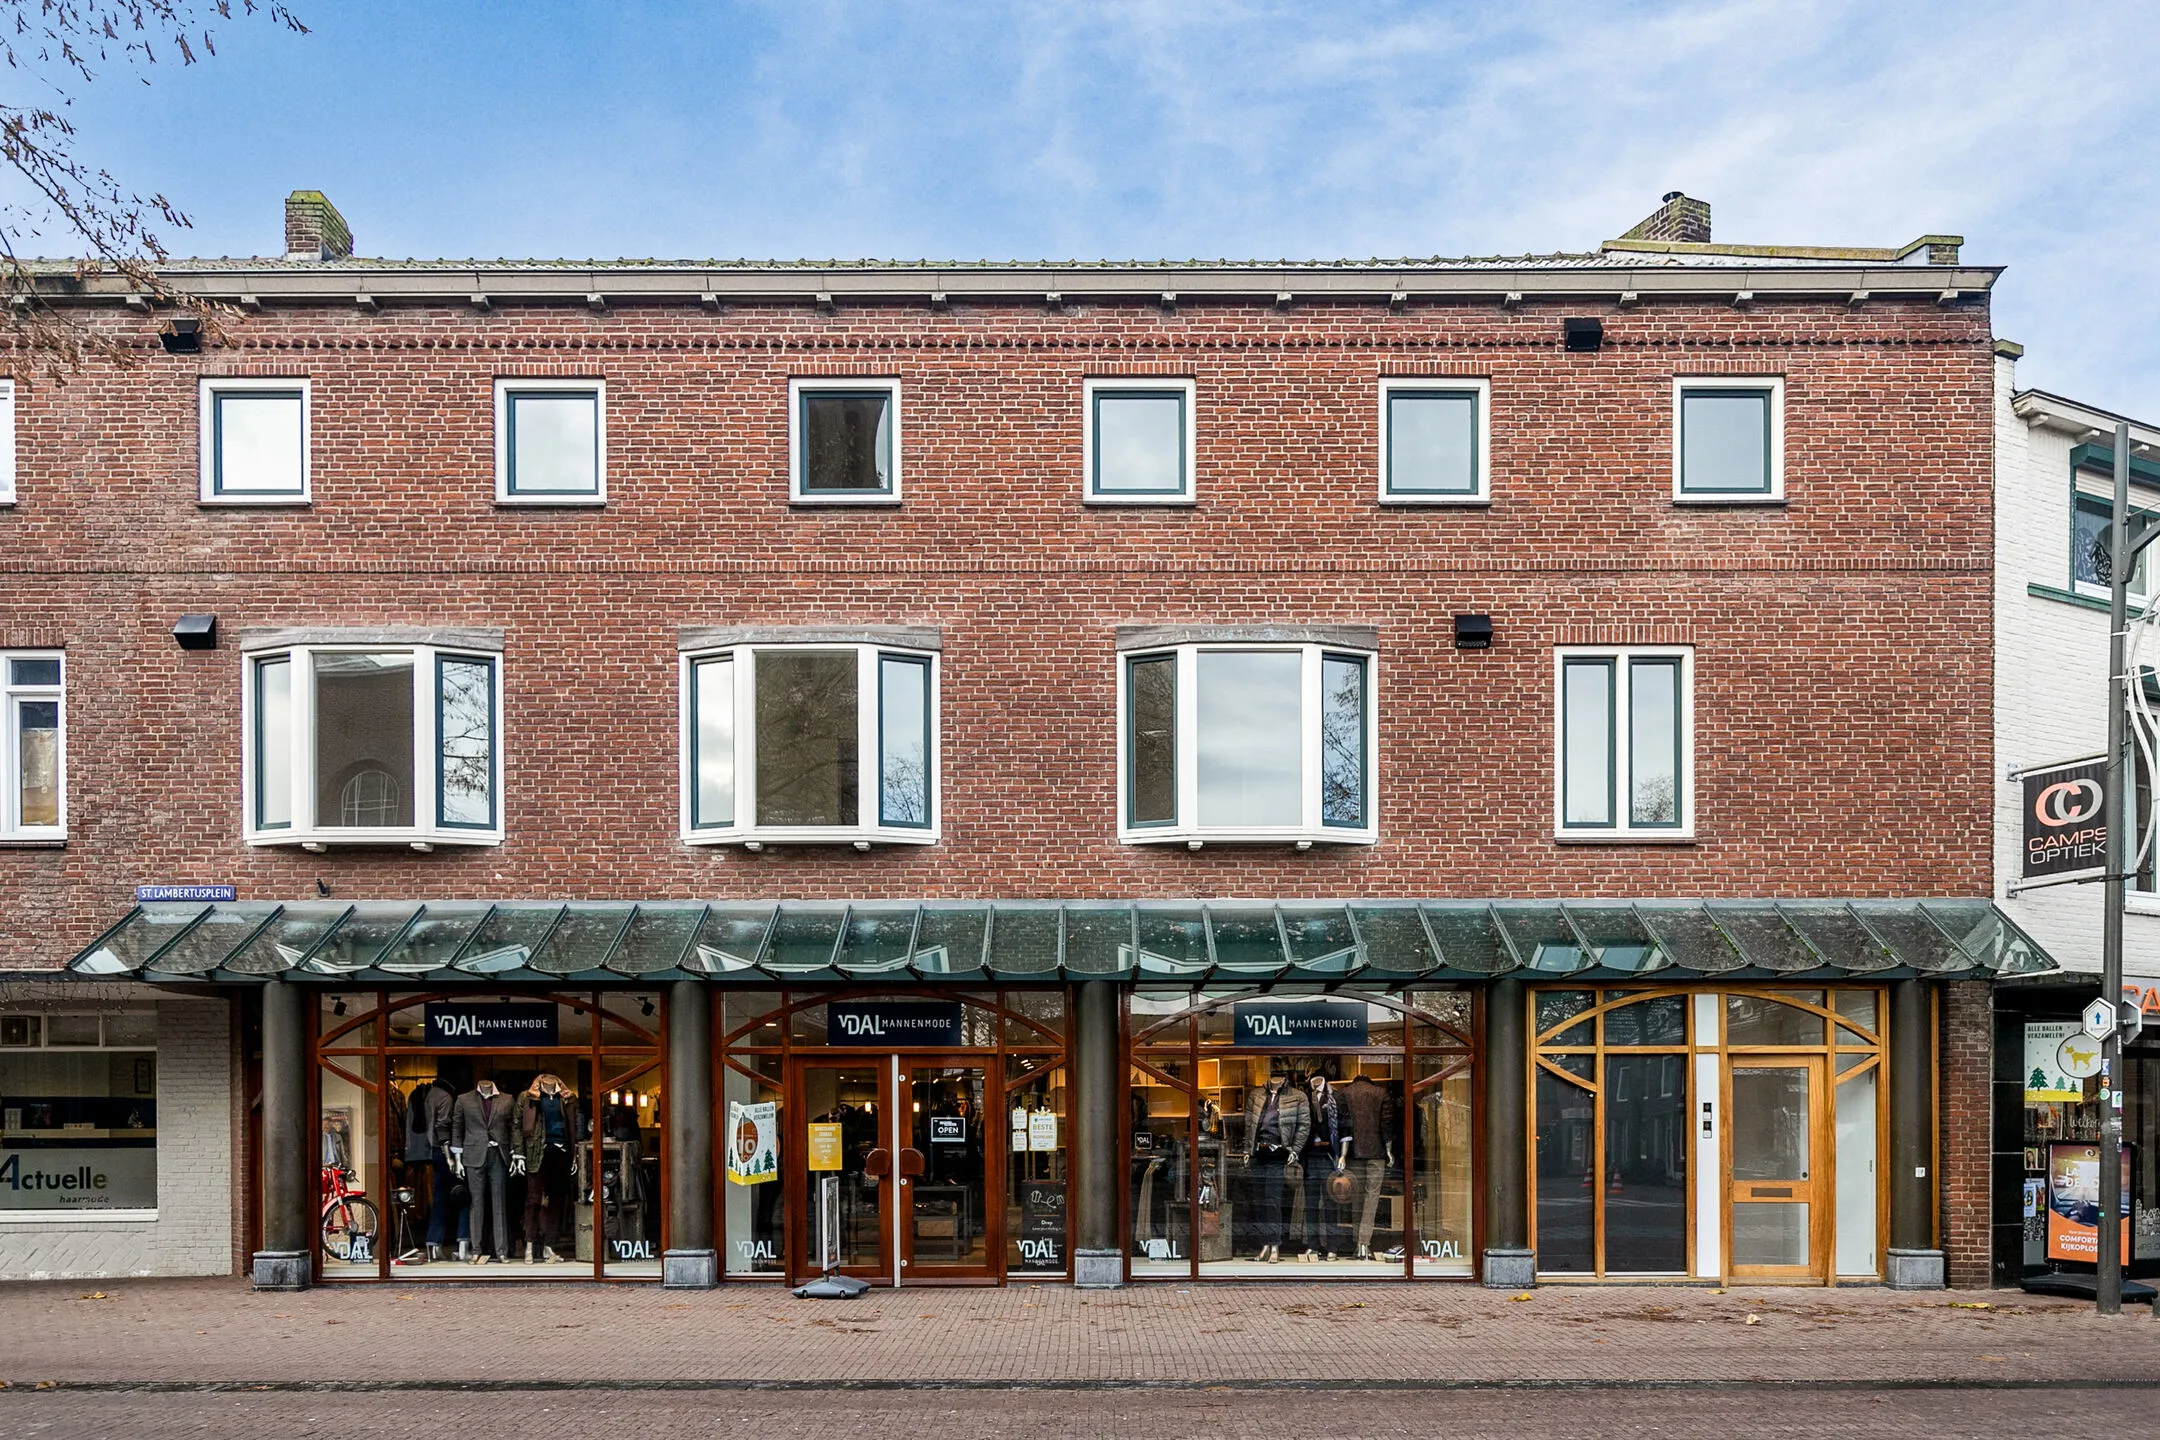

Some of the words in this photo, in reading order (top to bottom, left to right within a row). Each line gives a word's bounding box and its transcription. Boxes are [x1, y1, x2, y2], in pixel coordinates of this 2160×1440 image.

[2029, 827, 2107, 851] CAMPS
[2030, 841, 2106, 865] OPTIEK
[141, 888, 153, 898] ST.
[154, 888, 231, 898] LAMBERTUSPLEIN
[434, 1015, 482, 1036] VDAL
[478, 1019, 548, 1028] MANNENMODE
[838, 1014, 885, 1035] VDAL
[882, 1019, 951, 1028] MANNENMODE
[1244, 1015, 1292, 1036] VDAL
[1288, 1019, 1358, 1028] MANNENMODE
[0, 1154, 107, 1190] Actuelle
[612, 1240, 655, 1258] VDAL
[736, 1240, 777, 1258] VDAL
[1016, 1240, 1058, 1258] VDAL
[1421, 1240, 1463, 1258] VDAL
